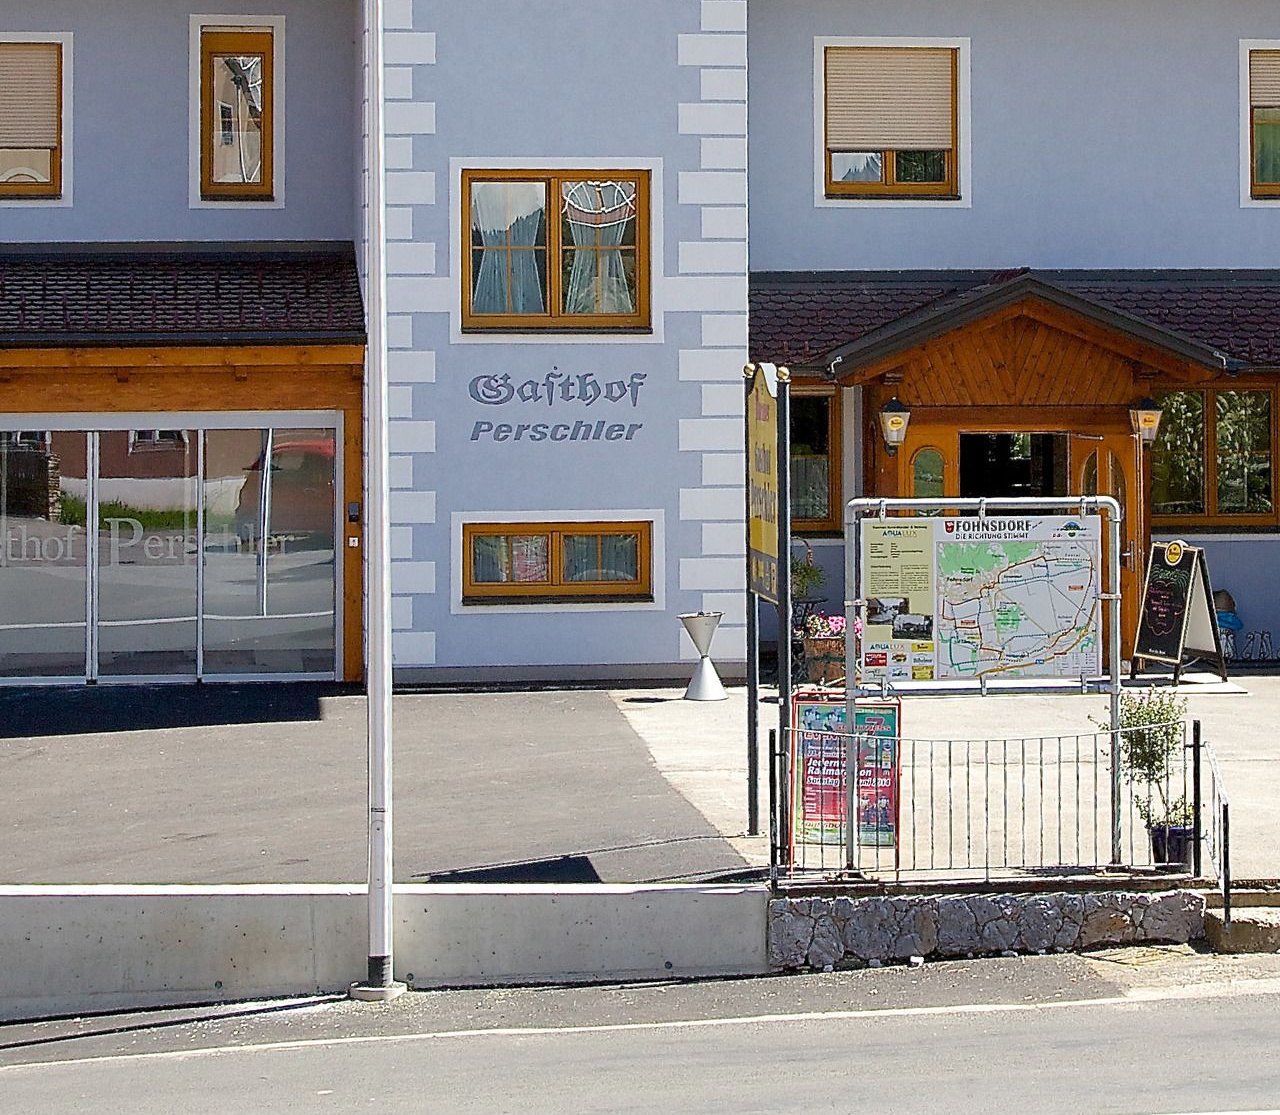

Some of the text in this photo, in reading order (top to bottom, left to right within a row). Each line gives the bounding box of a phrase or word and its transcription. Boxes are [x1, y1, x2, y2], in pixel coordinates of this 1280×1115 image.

[468, 366, 648, 407] Gasthof
[470, 420, 643, 442] Perschler
[956, 520, 1032, 532] FOHNSDORF
[104, 518, 294, 567] Pershler
[807, 766, 872, 776] Radmaron
